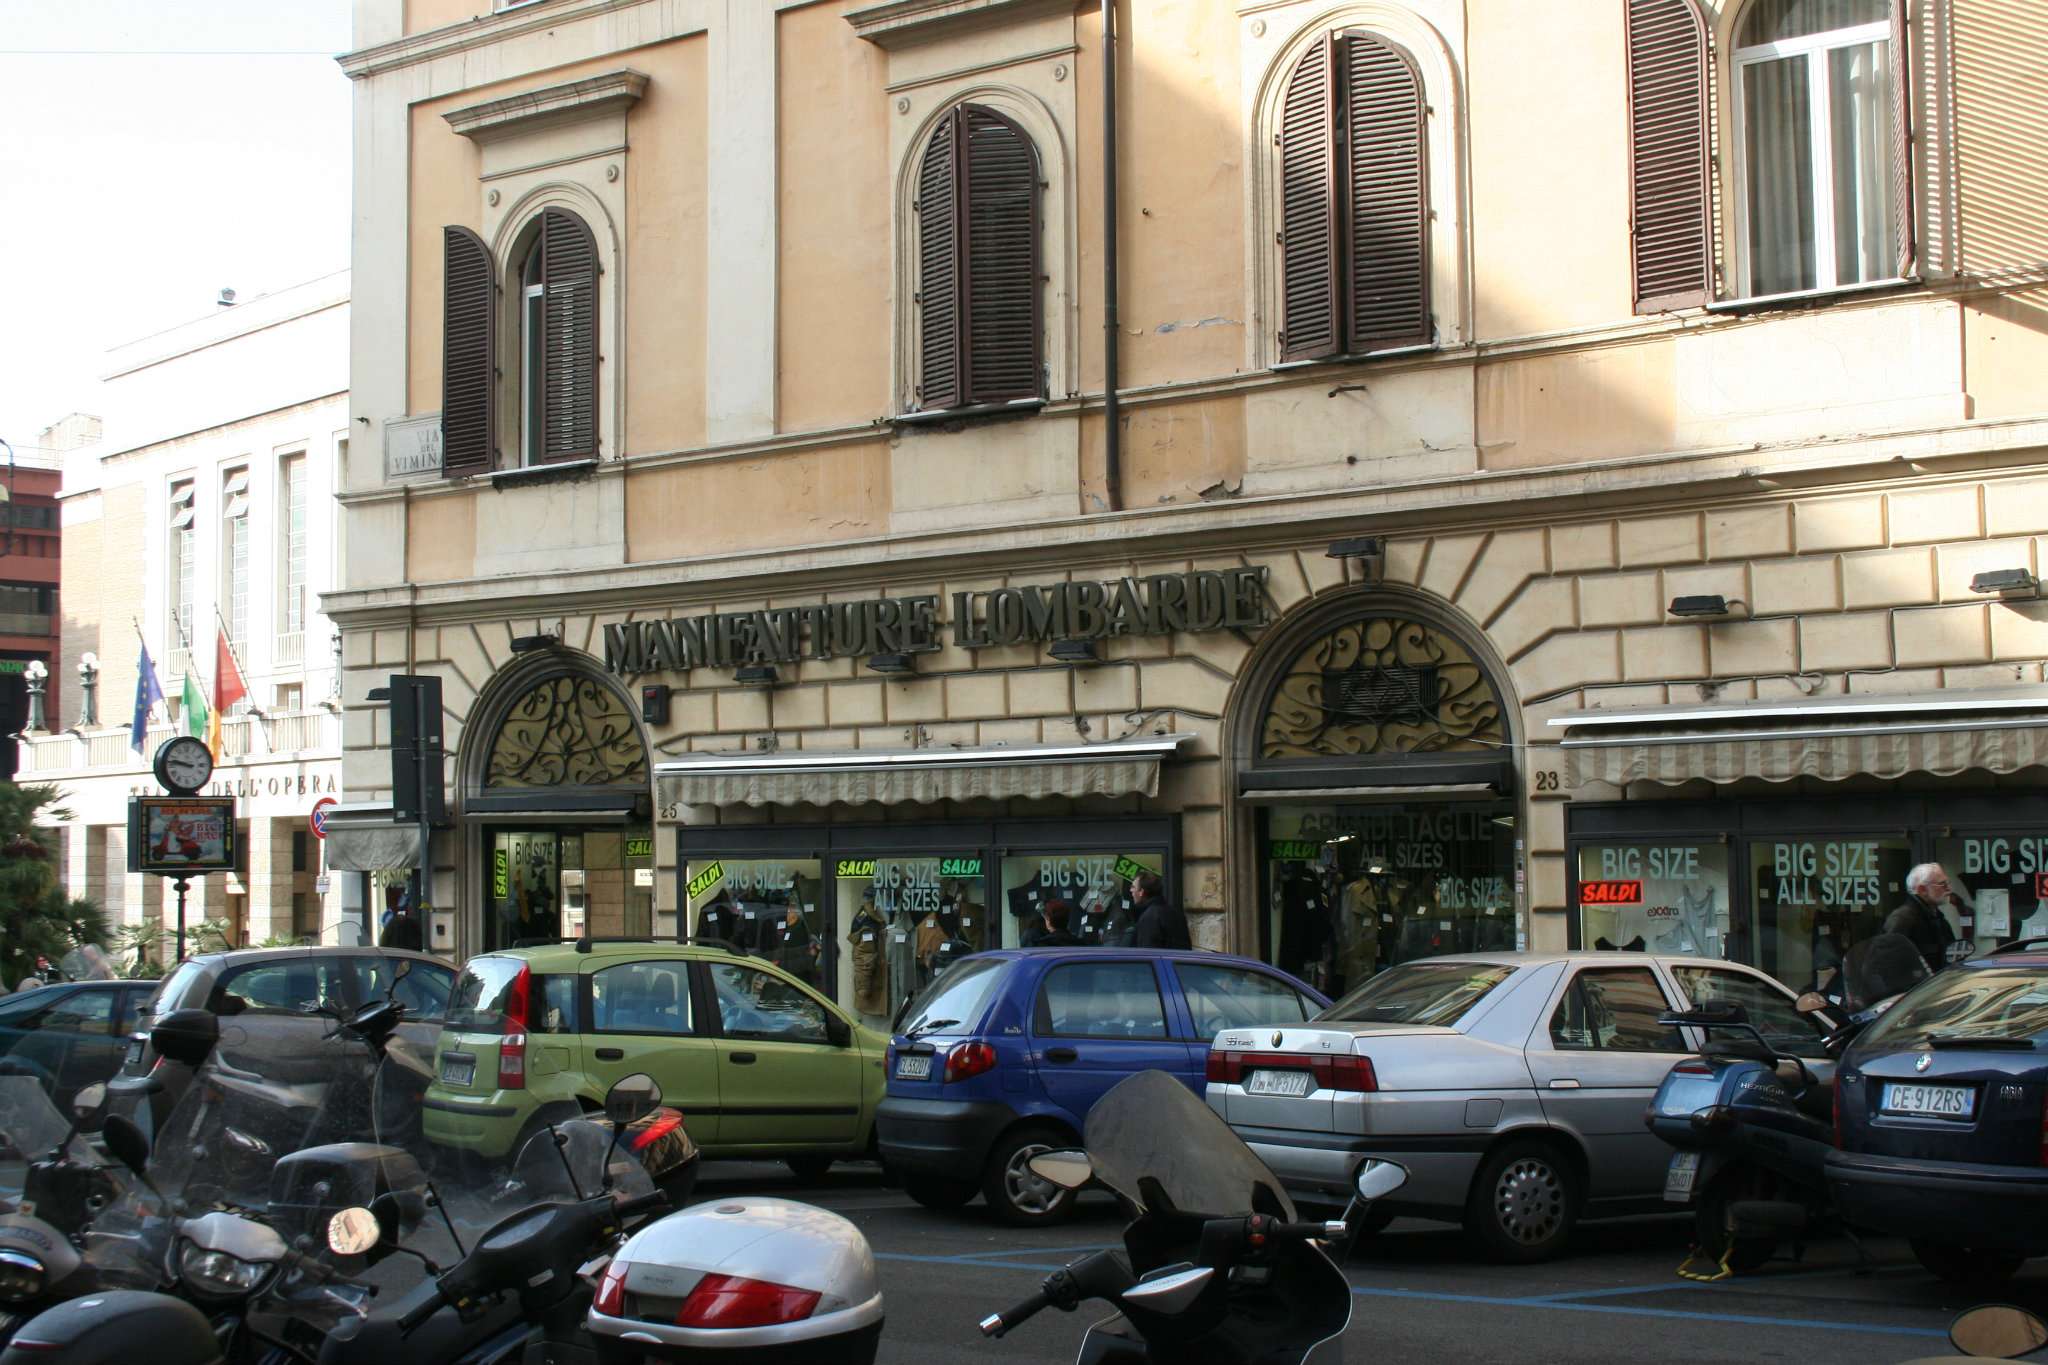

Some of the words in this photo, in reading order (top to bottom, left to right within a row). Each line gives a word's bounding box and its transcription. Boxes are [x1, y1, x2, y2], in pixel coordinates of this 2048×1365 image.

[394, 452, 443, 470] VIMIN
[603, 594, 942, 675] MANIFATTURE
[952, 566, 1270, 648] LOMBARDE
[1535, 770, 1559, 791] 23
[838, 860, 876, 875] SALDI
[942, 860, 980, 874] SALDI
[1396, 843, 1444, 868] SIZES
[1602, 847, 1641, 879] BIG
[1649, 847, 1700, 880] SIZE
[1775, 842, 1816, 877] BIG
[1825, 842, 1880, 877] SIZE
[1964, 838, 2011, 874] BIG
[495, 853, 507, 895] SALDI
[689, 866, 720, 898] SALDI
[725, 863, 749, 889] BIG
[754, 863, 787, 889] SIZE
[874, 862, 900, 889] BIG
[905, 861, 940, 889] SIZE
[1040, 859, 1070, 887] BIG
[1075, 859, 1114, 887] SIZE
[874, 889, 899, 912] ALL
[902, 888, 940, 912] SIZES
[1583, 883, 1638, 902] SALDI
[1777, 877, 1816, 905] ALL
[1822, 877, 1880, 905] SIZES
